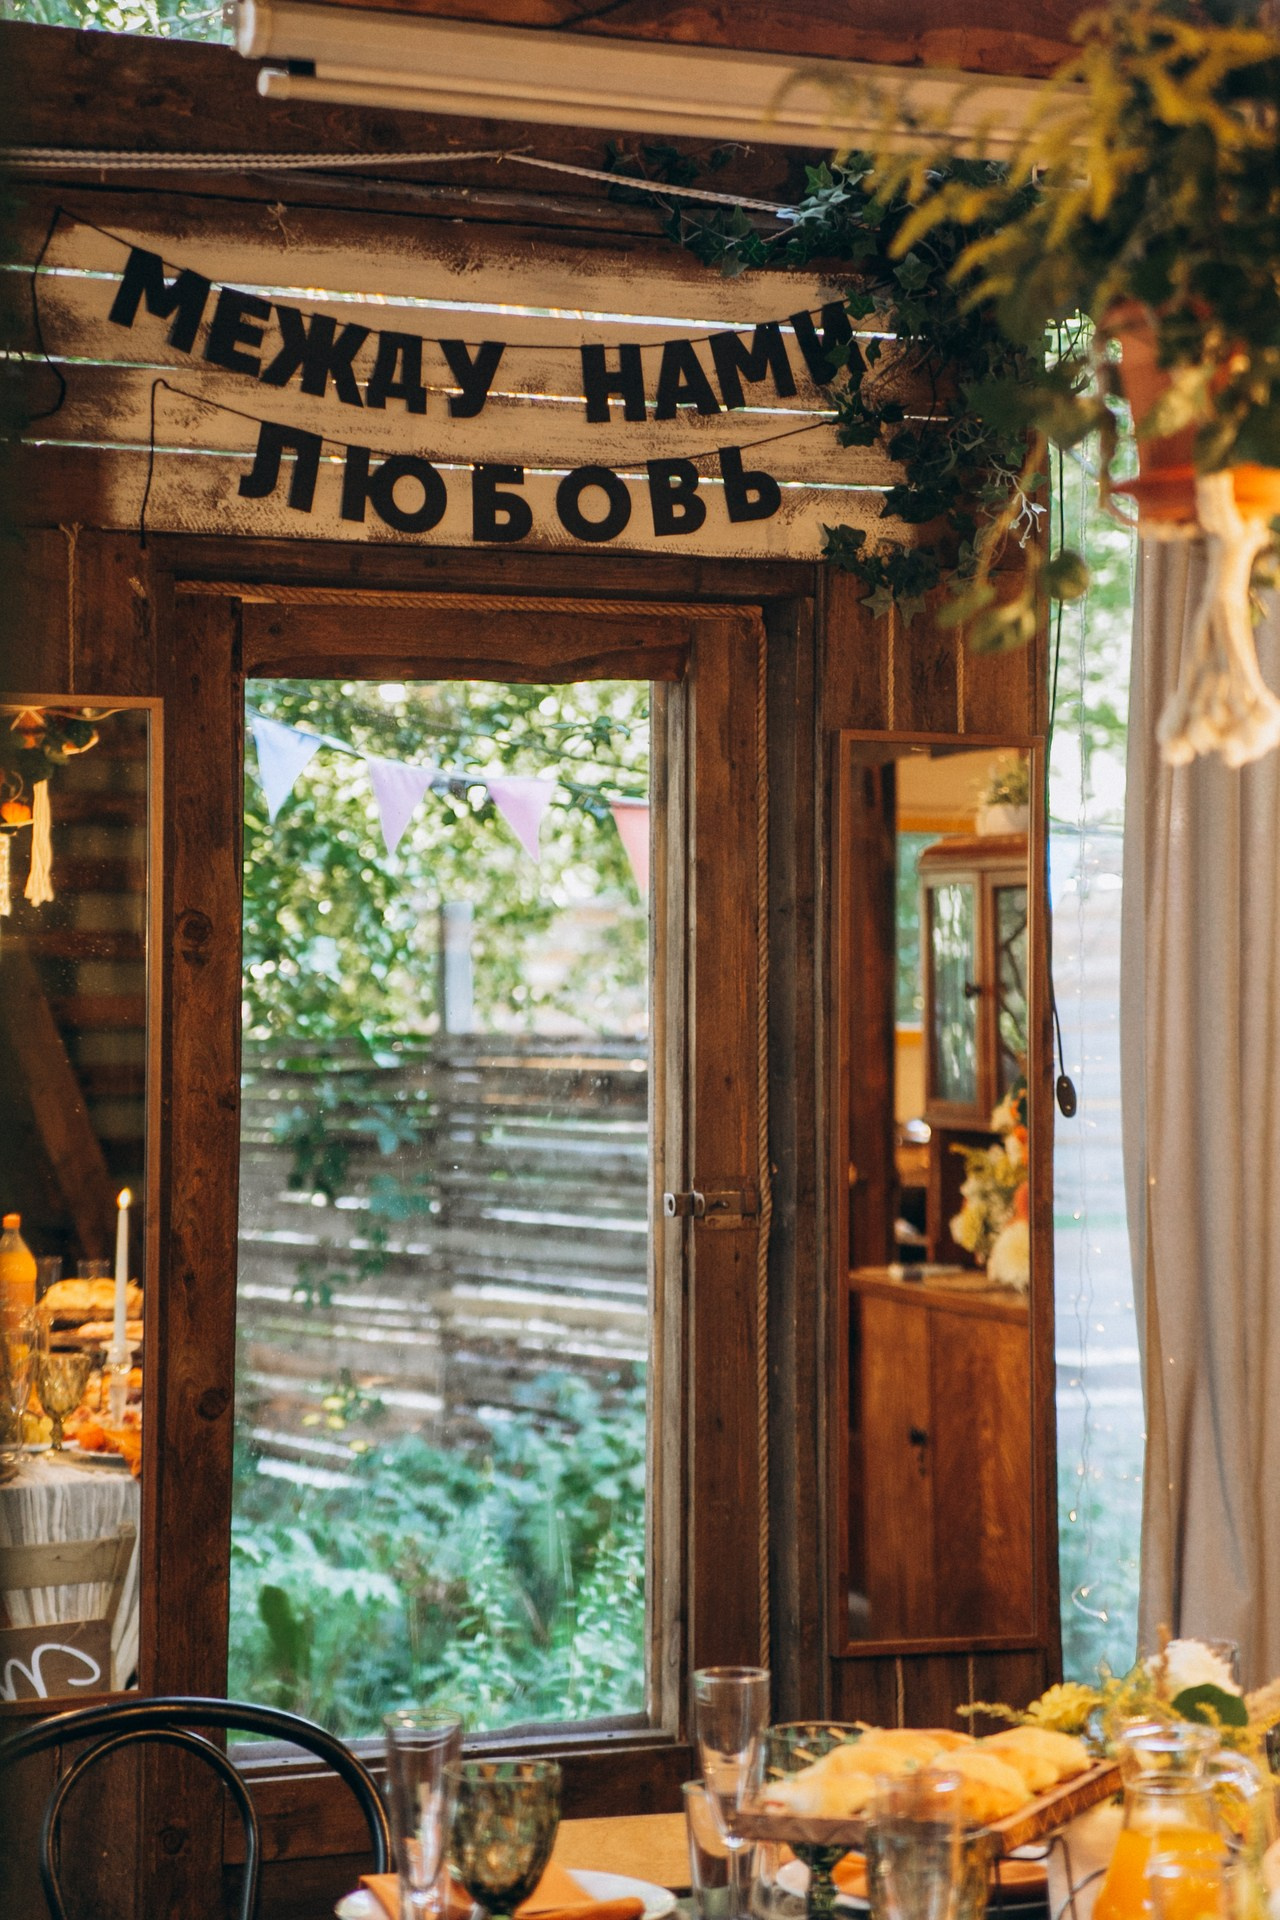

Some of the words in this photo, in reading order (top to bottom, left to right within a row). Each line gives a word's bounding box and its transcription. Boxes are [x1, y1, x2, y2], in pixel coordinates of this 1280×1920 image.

[109, 247, 506, 418] МЕЖДУ
[580, 301, 868, 423] НАМИ
[238, 420, 782, 543] ЛЮБОВЬ
